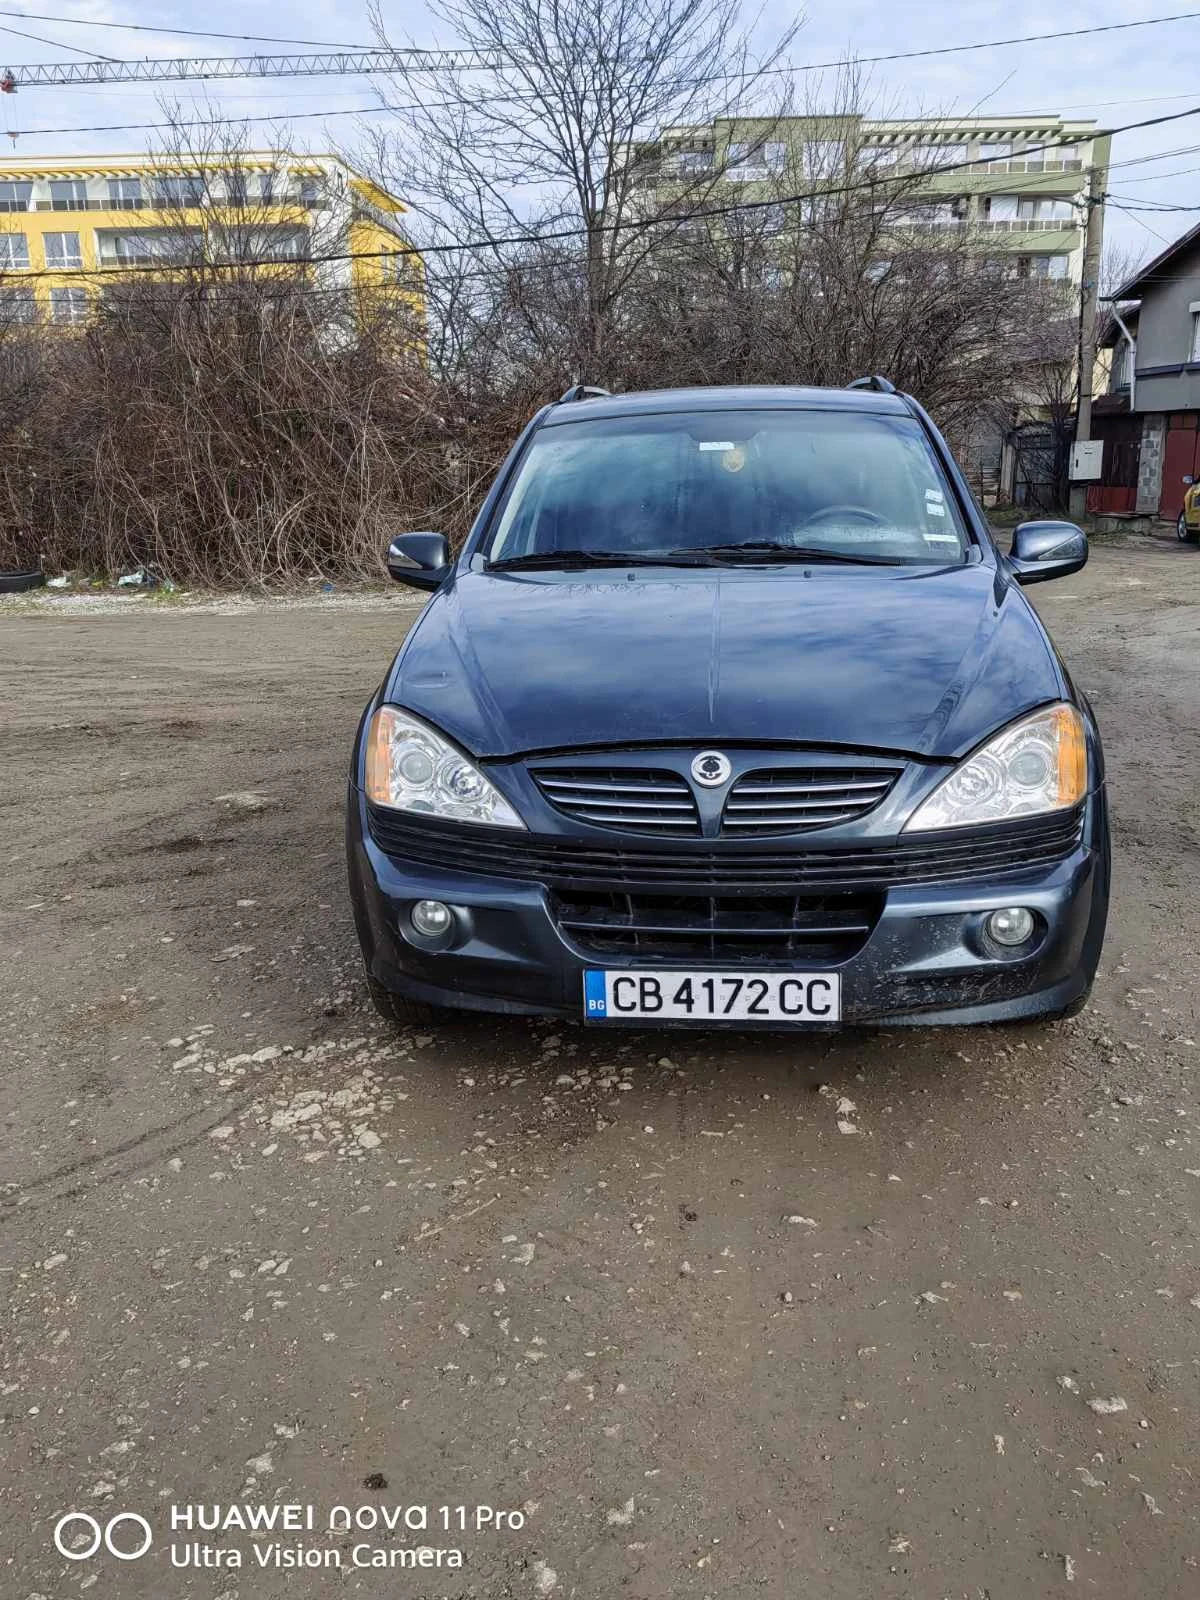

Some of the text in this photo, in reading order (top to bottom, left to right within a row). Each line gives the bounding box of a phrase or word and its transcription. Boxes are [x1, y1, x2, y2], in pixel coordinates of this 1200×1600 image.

[589, 1000, 605, 1010] BG
[612, 976, 832, 1016] CB 4172 CC
